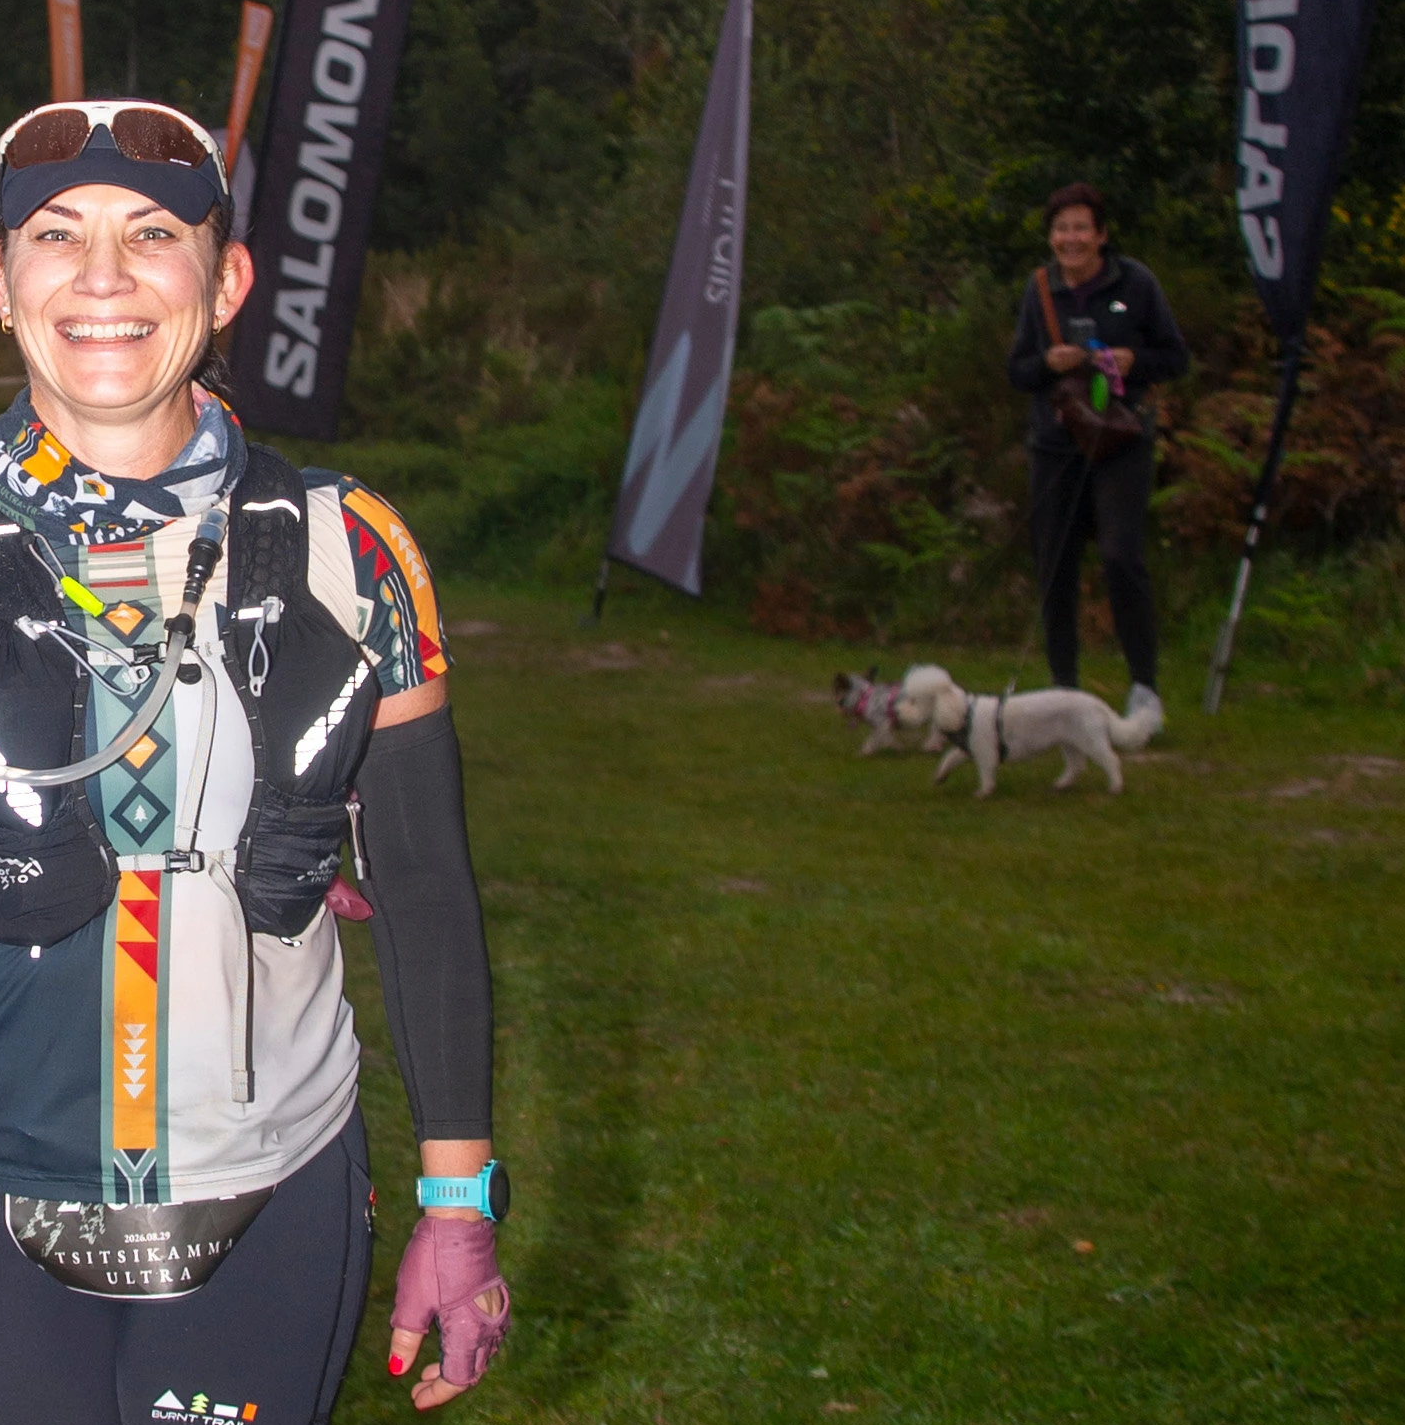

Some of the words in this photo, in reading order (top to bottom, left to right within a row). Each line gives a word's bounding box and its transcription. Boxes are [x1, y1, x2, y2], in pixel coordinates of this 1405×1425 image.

[124, 1231, 171, 1244] 2026.08.29
[54, 1238, 234, 1265] TSITSIKAMMA
[106, 1267, 192, 1286] ULTRA
[151, 1409, 199, 1423] BURNT
